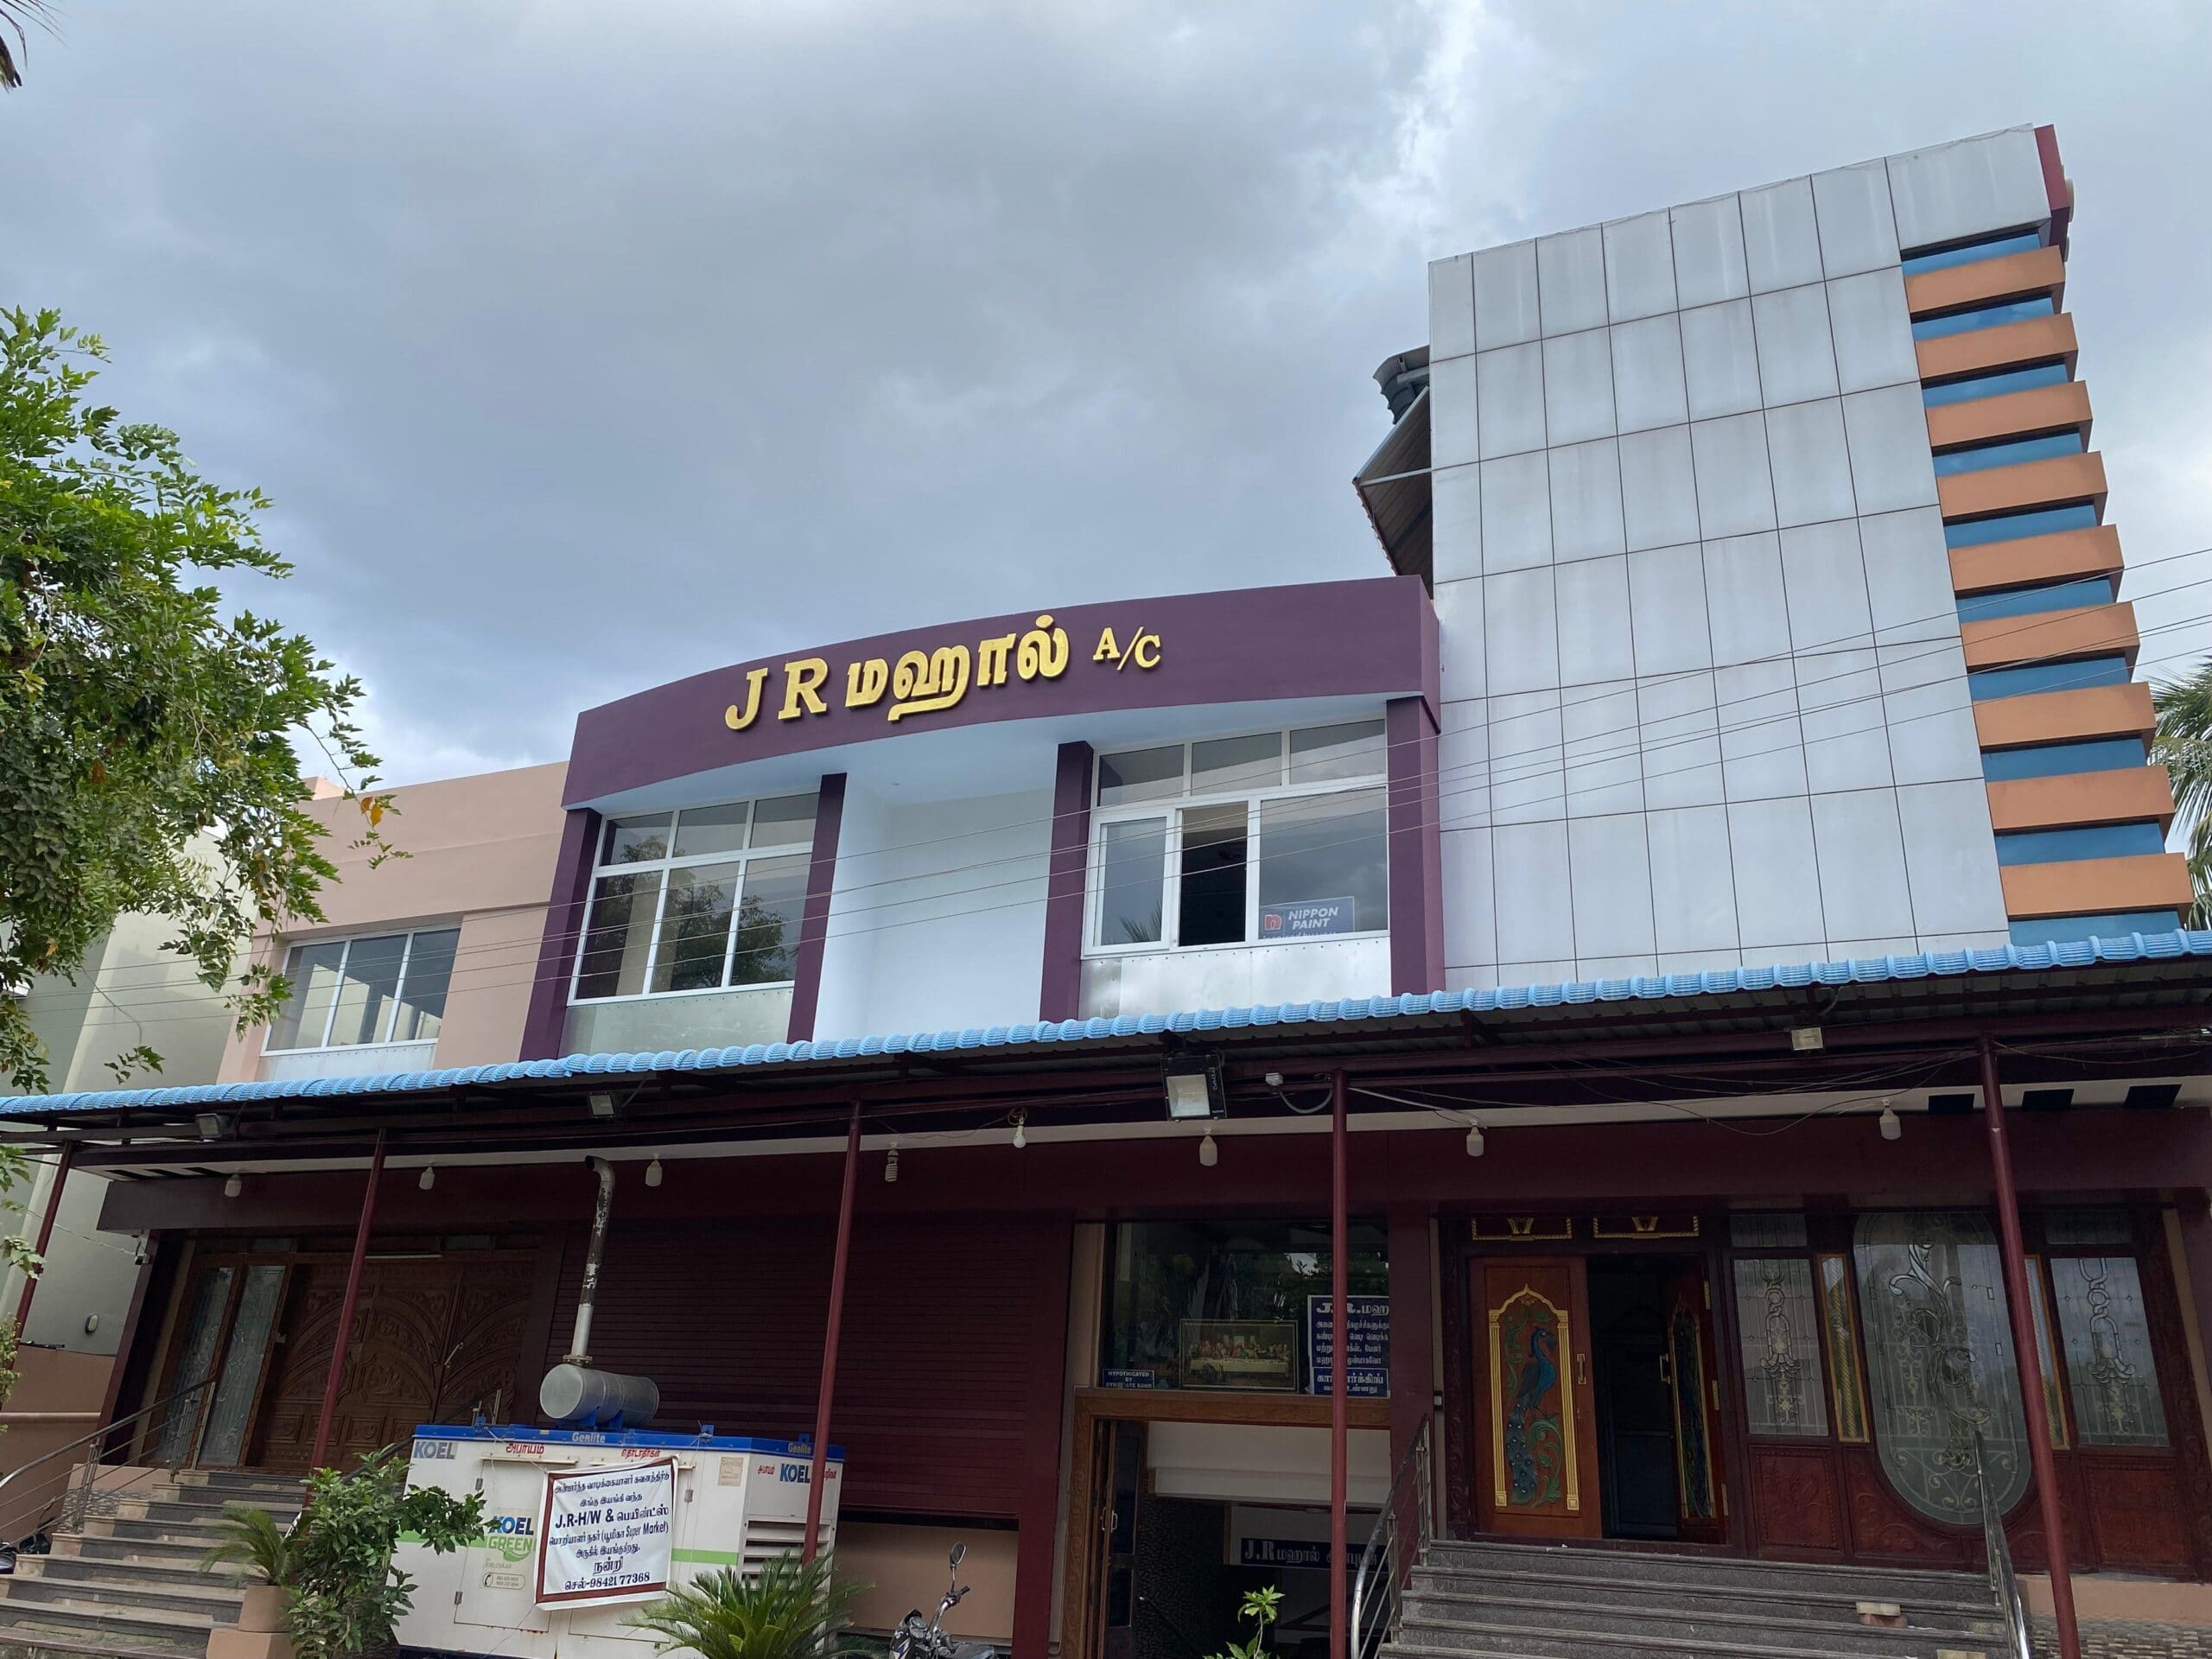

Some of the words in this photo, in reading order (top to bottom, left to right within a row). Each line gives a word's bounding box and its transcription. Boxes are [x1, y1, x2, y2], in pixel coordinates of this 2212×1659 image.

[845, 614, 1070, 722] மஹால்
[1092, 626, 1162, 671] A/C
[1288, 906, 1338, 920] NIPPON
[1293, 918, 1331, 930] PAINT
[572, 1432, 606, 1443] Genlite
[413, 1441, 455, 1459] KOEL
[505, 1443, 545, 1455] அபாயம்
[788, 1443, 811, 1455] Genlite
[779, 1463, 810, 1484] KOEL
[555, 1510, 601, 1529] J.R-H/W
[605, 1509, 614, 1522] &
[626, 1525, 641, 1540] Super
[643, 1521, 669, 1535] Market)
[488, 1535, 533, 1552] GREEN
[593, 1556, 624, 1575] நன்றி
